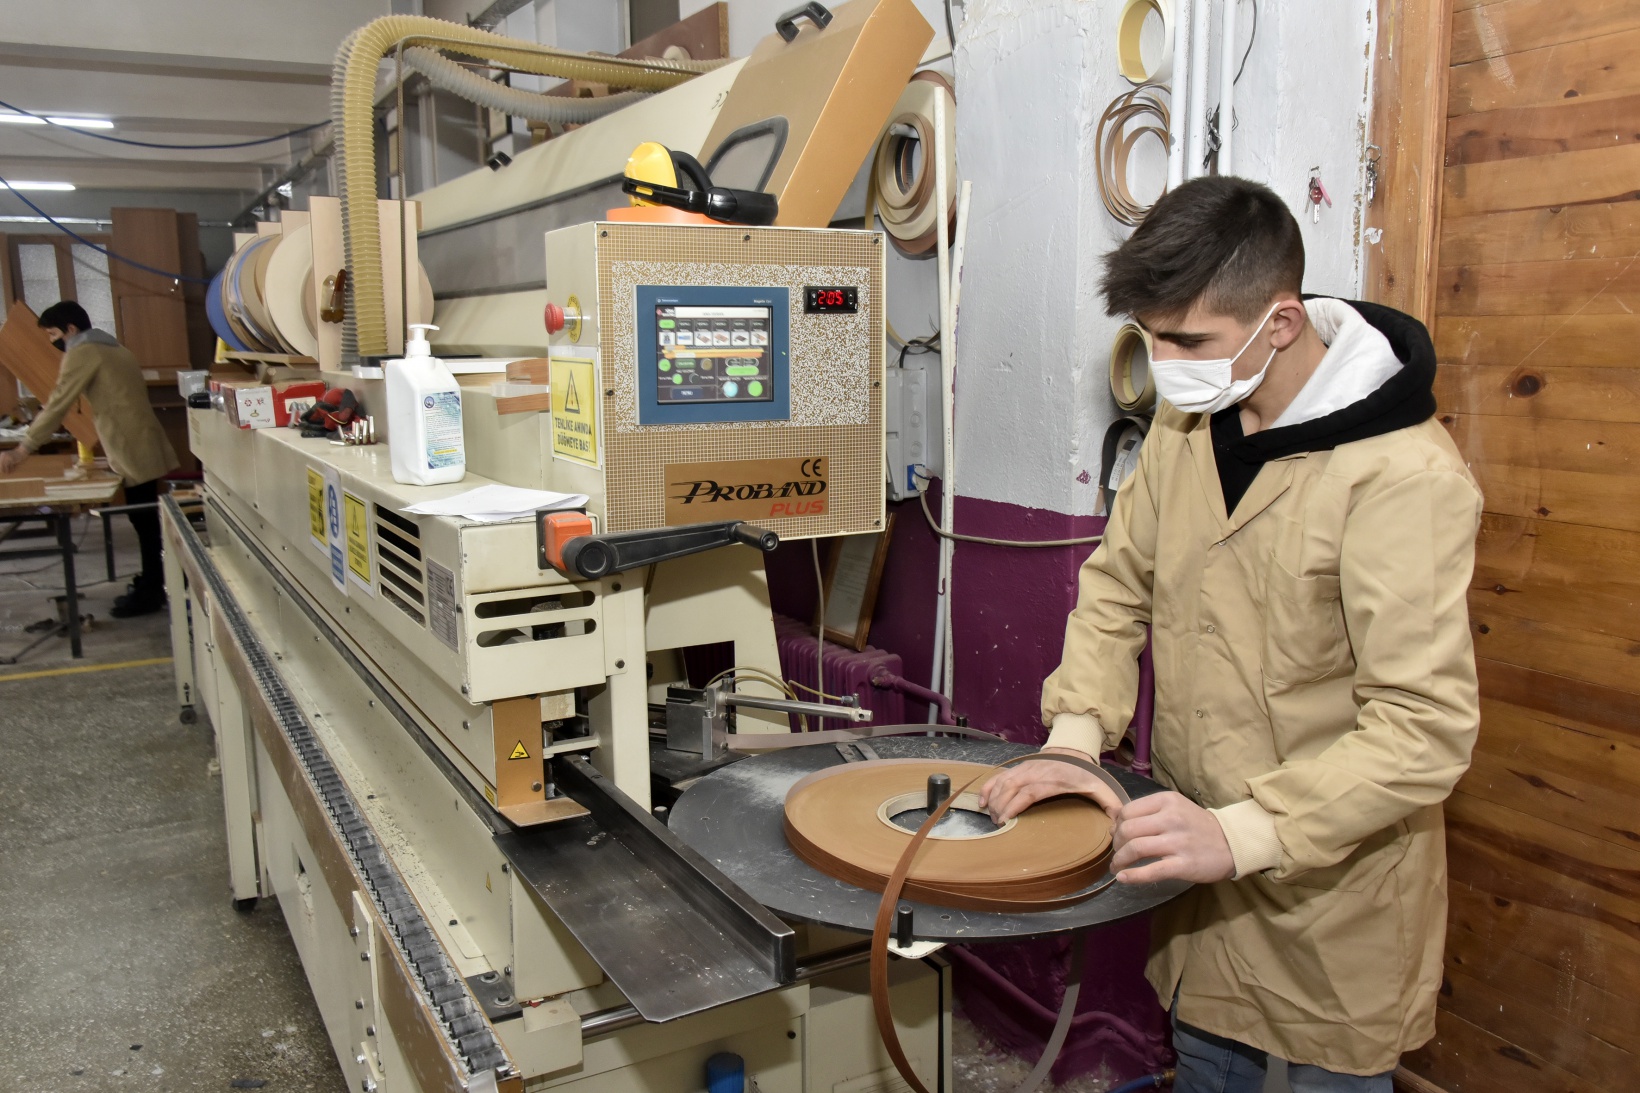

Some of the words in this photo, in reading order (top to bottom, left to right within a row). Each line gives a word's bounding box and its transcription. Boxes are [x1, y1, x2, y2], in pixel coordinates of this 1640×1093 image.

[817, 290, 844, 306] 205
[801, 459, 822, 477] CE
[668, 480, 827, 504] PROBAND
[769, 500, 825, 516] PLUS
